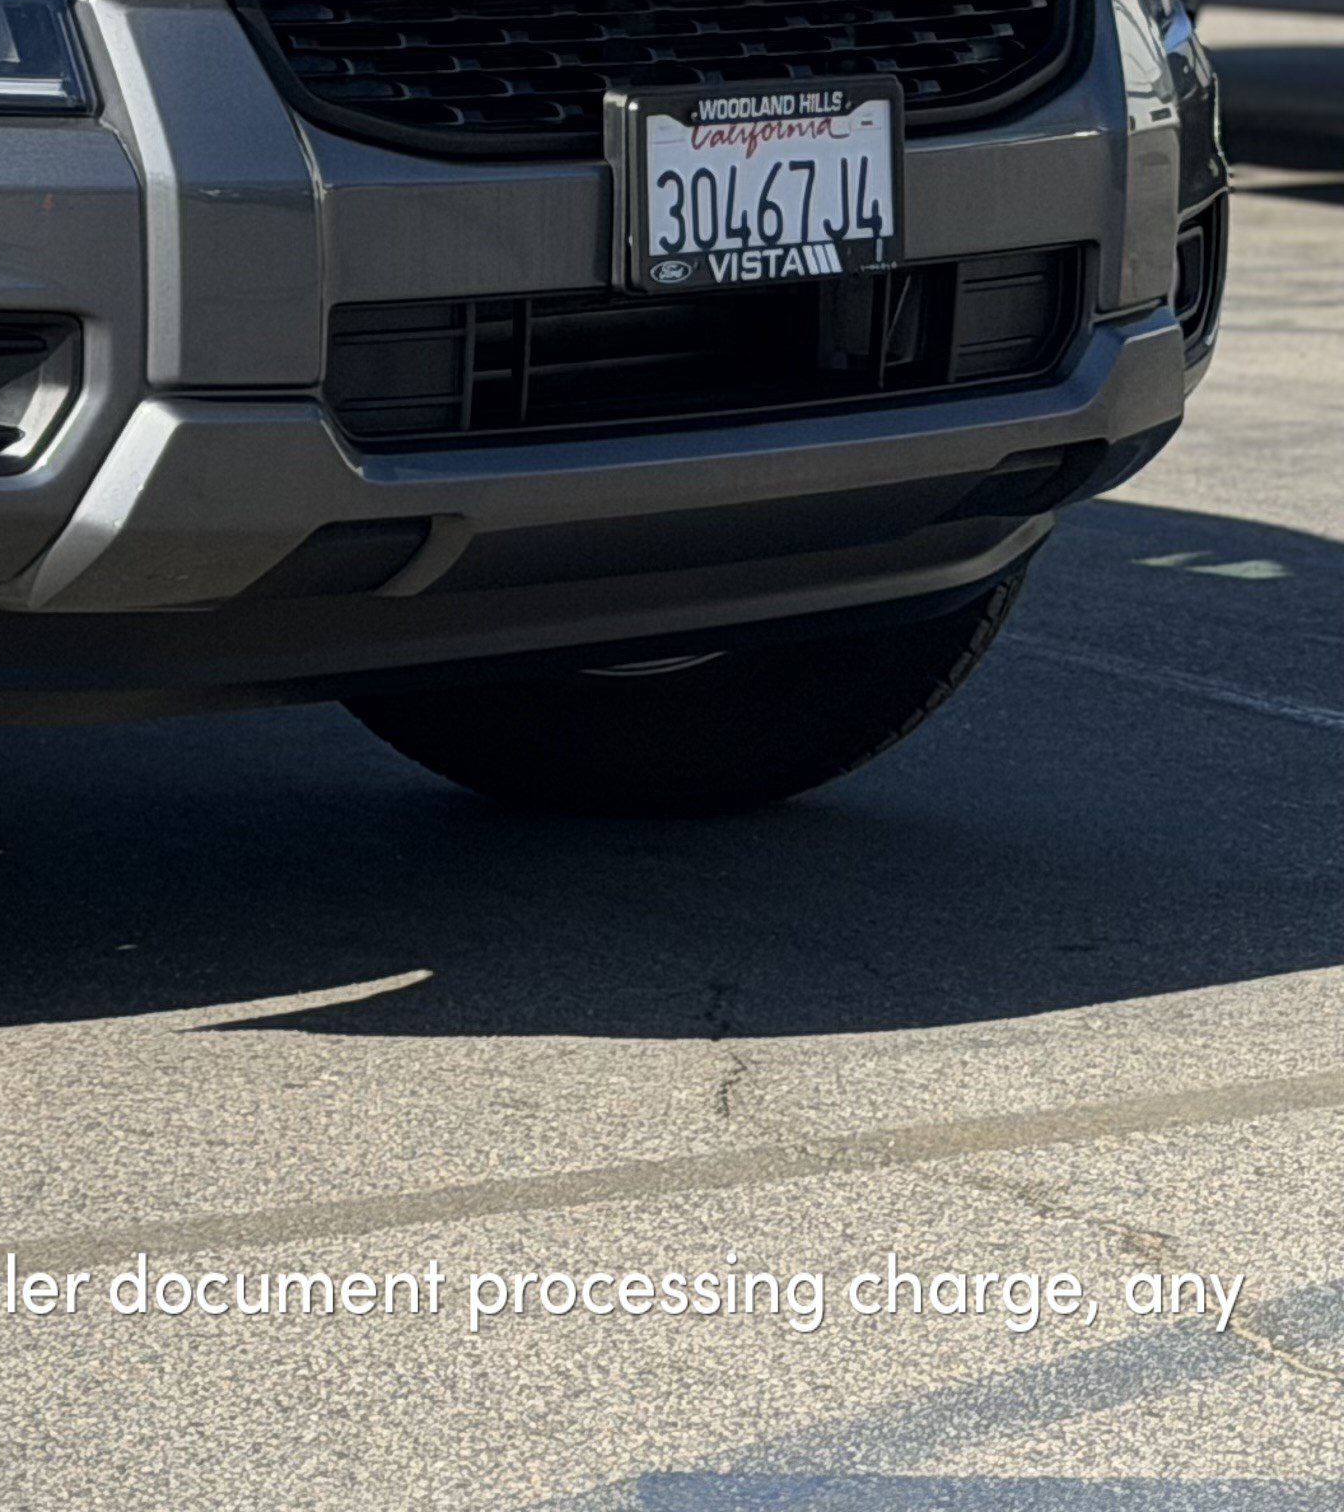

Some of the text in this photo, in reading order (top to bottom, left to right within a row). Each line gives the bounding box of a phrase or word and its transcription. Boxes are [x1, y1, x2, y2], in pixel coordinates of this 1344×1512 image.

[698, 90, 844, 121] WOODLAND HILLS
[656, 155, 883, 254] 30467J4
[708, 244, 805, 283] VISTA
